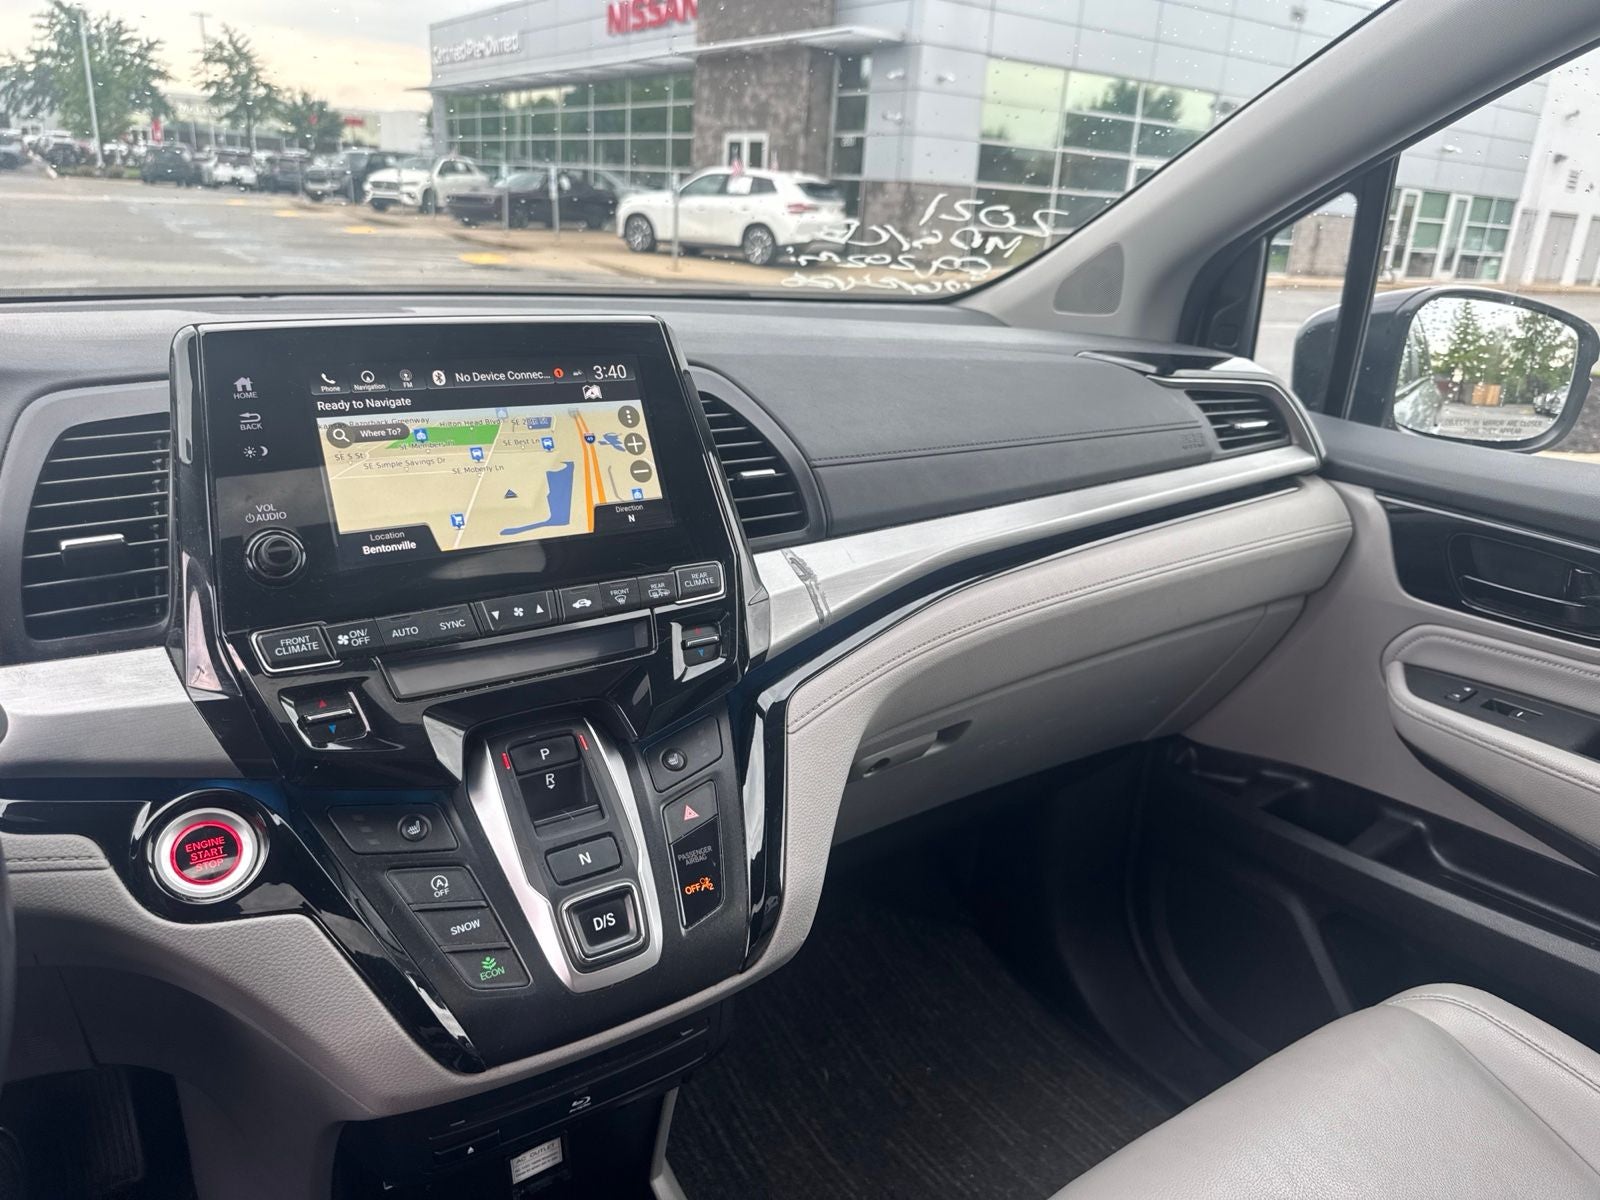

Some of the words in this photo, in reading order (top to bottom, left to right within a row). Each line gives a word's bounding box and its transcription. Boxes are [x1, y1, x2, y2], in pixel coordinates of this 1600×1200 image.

[607, 0, 698, 35] NISSAN
[455, 372, 471, 382] No
[472, 370, 506, 382] Device
[593, 364, 627, 380] 3:40
[321, 385, 341, 393] Phone
[353, 383, 386, 392] Navigation
[403, 381, 413, 389] FM
[233, 392, 258, 400] HOME
[317, 400, 350, 412] Ready
[352, 400, 364, 409] to
[366, 397, 412, 409] Navigate
[240, 423, 263, 431] BACK
[360, 428, 386, 438] Where
[386, 427, 401, 437] To?
[363, 462, 374, 470] SE
[376, 461, 402, 469] Simple
[405, 458, 435, 467] Savings
[255, 504, 277, 513] VOL
[615, 504, 644, 513] Direction
[256, 512, 287, 522] AUDIO
[628, 515, 636, 523] N
[369, 531, 405, 542] Location
[362, 540, 417, 555] Bentonville
[691, 571, 708, 579] REAR
[650, 581, 666, 589] REAR
[684, 576, 715, 587] CLIMATE
[610, 587, 630, 596] FRONT
[439, 618, 467, 631] SYNC
[348, 628, 368, 638] ON/
[391, 625, 419, 638] AUTO
[280, 634, 311, 647] FRONT
[351, 636, 371, 647] OFF
[274, 641, 320, 657] CLIMATE
[540, 748, 550, 760] P
[545, 773, 555, 785] R
[185, 837, 225, 852] ENGINE
[190, 847, 224, 861] START
[578, 851, 593, 866] N
[677, 845, 712, 860] PASSENGER
[195, 859, 224, 872] STOP
[434, 888, 450, 898] OFF
[684, 883, 701, 895] OFF
[450, 919, 481, 936] SNOW
[592, 912, 616, 931] D/S
[479, 966, 506, 982] ECON
